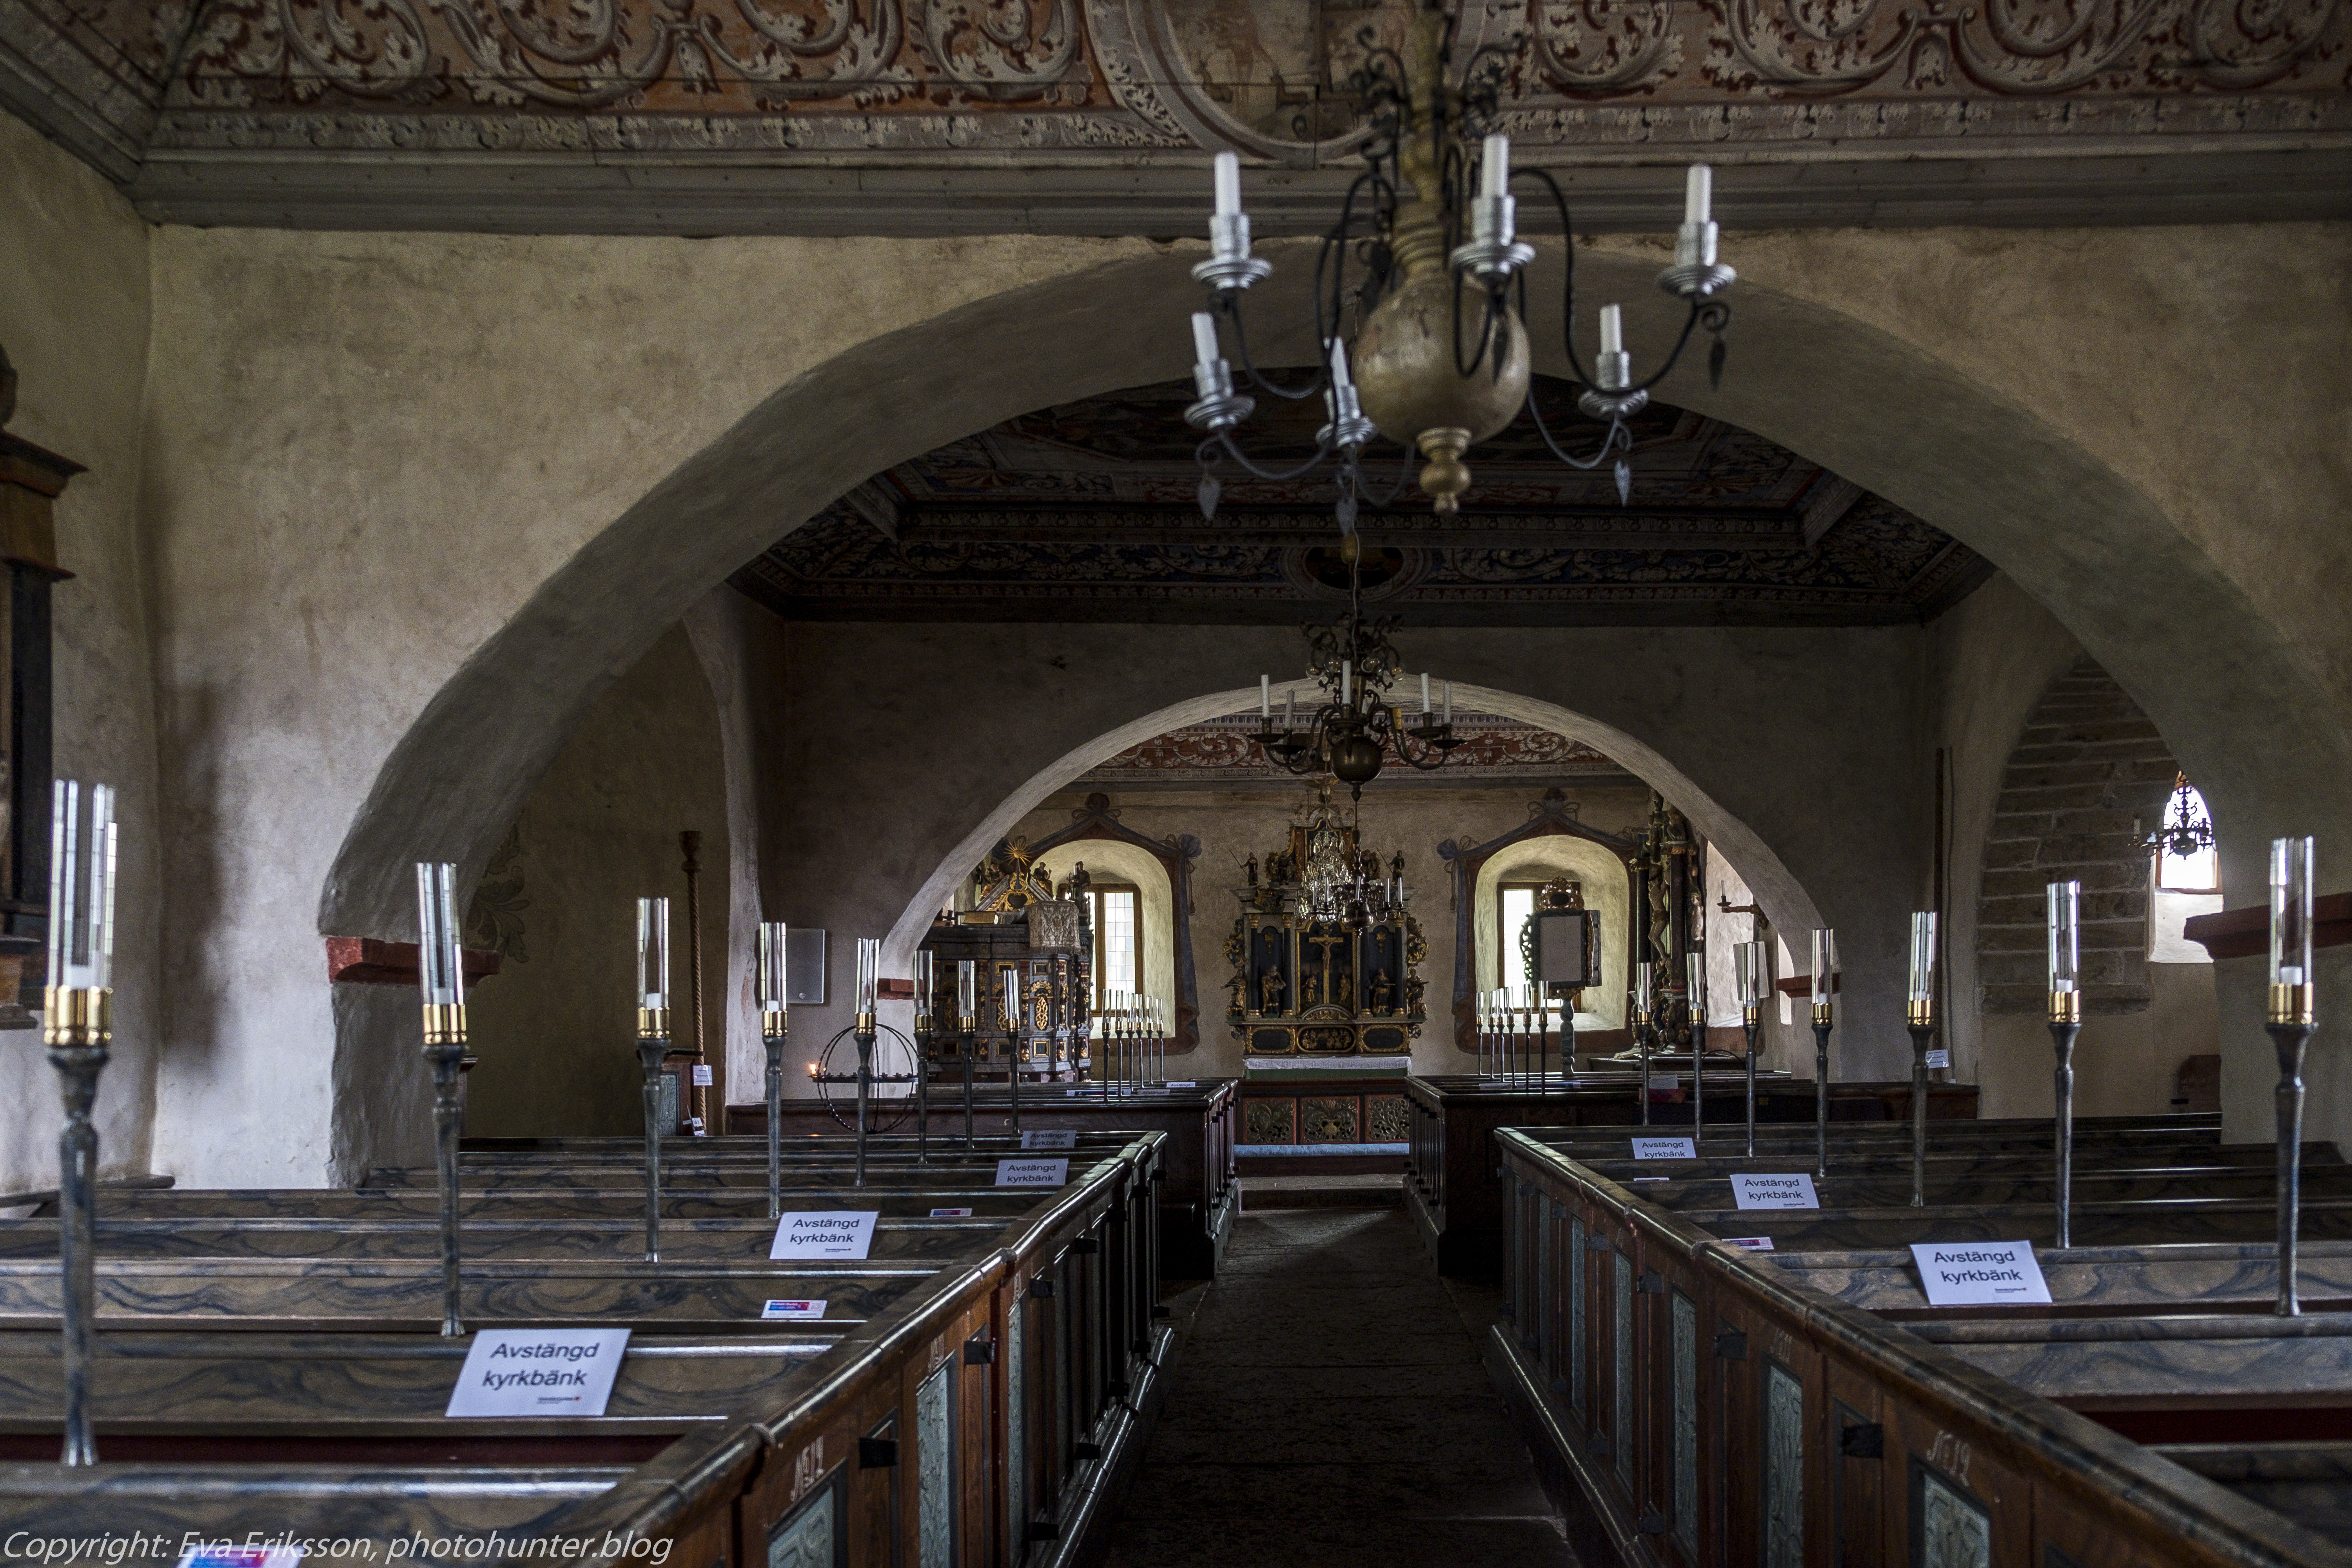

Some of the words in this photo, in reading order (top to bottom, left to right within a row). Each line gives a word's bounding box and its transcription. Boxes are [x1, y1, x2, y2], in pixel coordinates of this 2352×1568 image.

[1007, 1164, 1056, 1172] Avstängd
[1007, 1174, 1054, 1183] kyrkbänk
[1745, 1179, 1800, 1189] Avstängd
[1748, 1191, 1803, 1201] kyrkbänk
[793, 1219, 860, 1230] Avstängd
[789, 1233, 854, 1245] kyrkbänk
[1934, 1250, 2016, 1264] Avstängd
[1940, 1269, 2023, 1285] kyrkbänk
[489, 1343, 600, 1362] Avstängd
[481, 1370, 588, 1391] kyrkbänk
